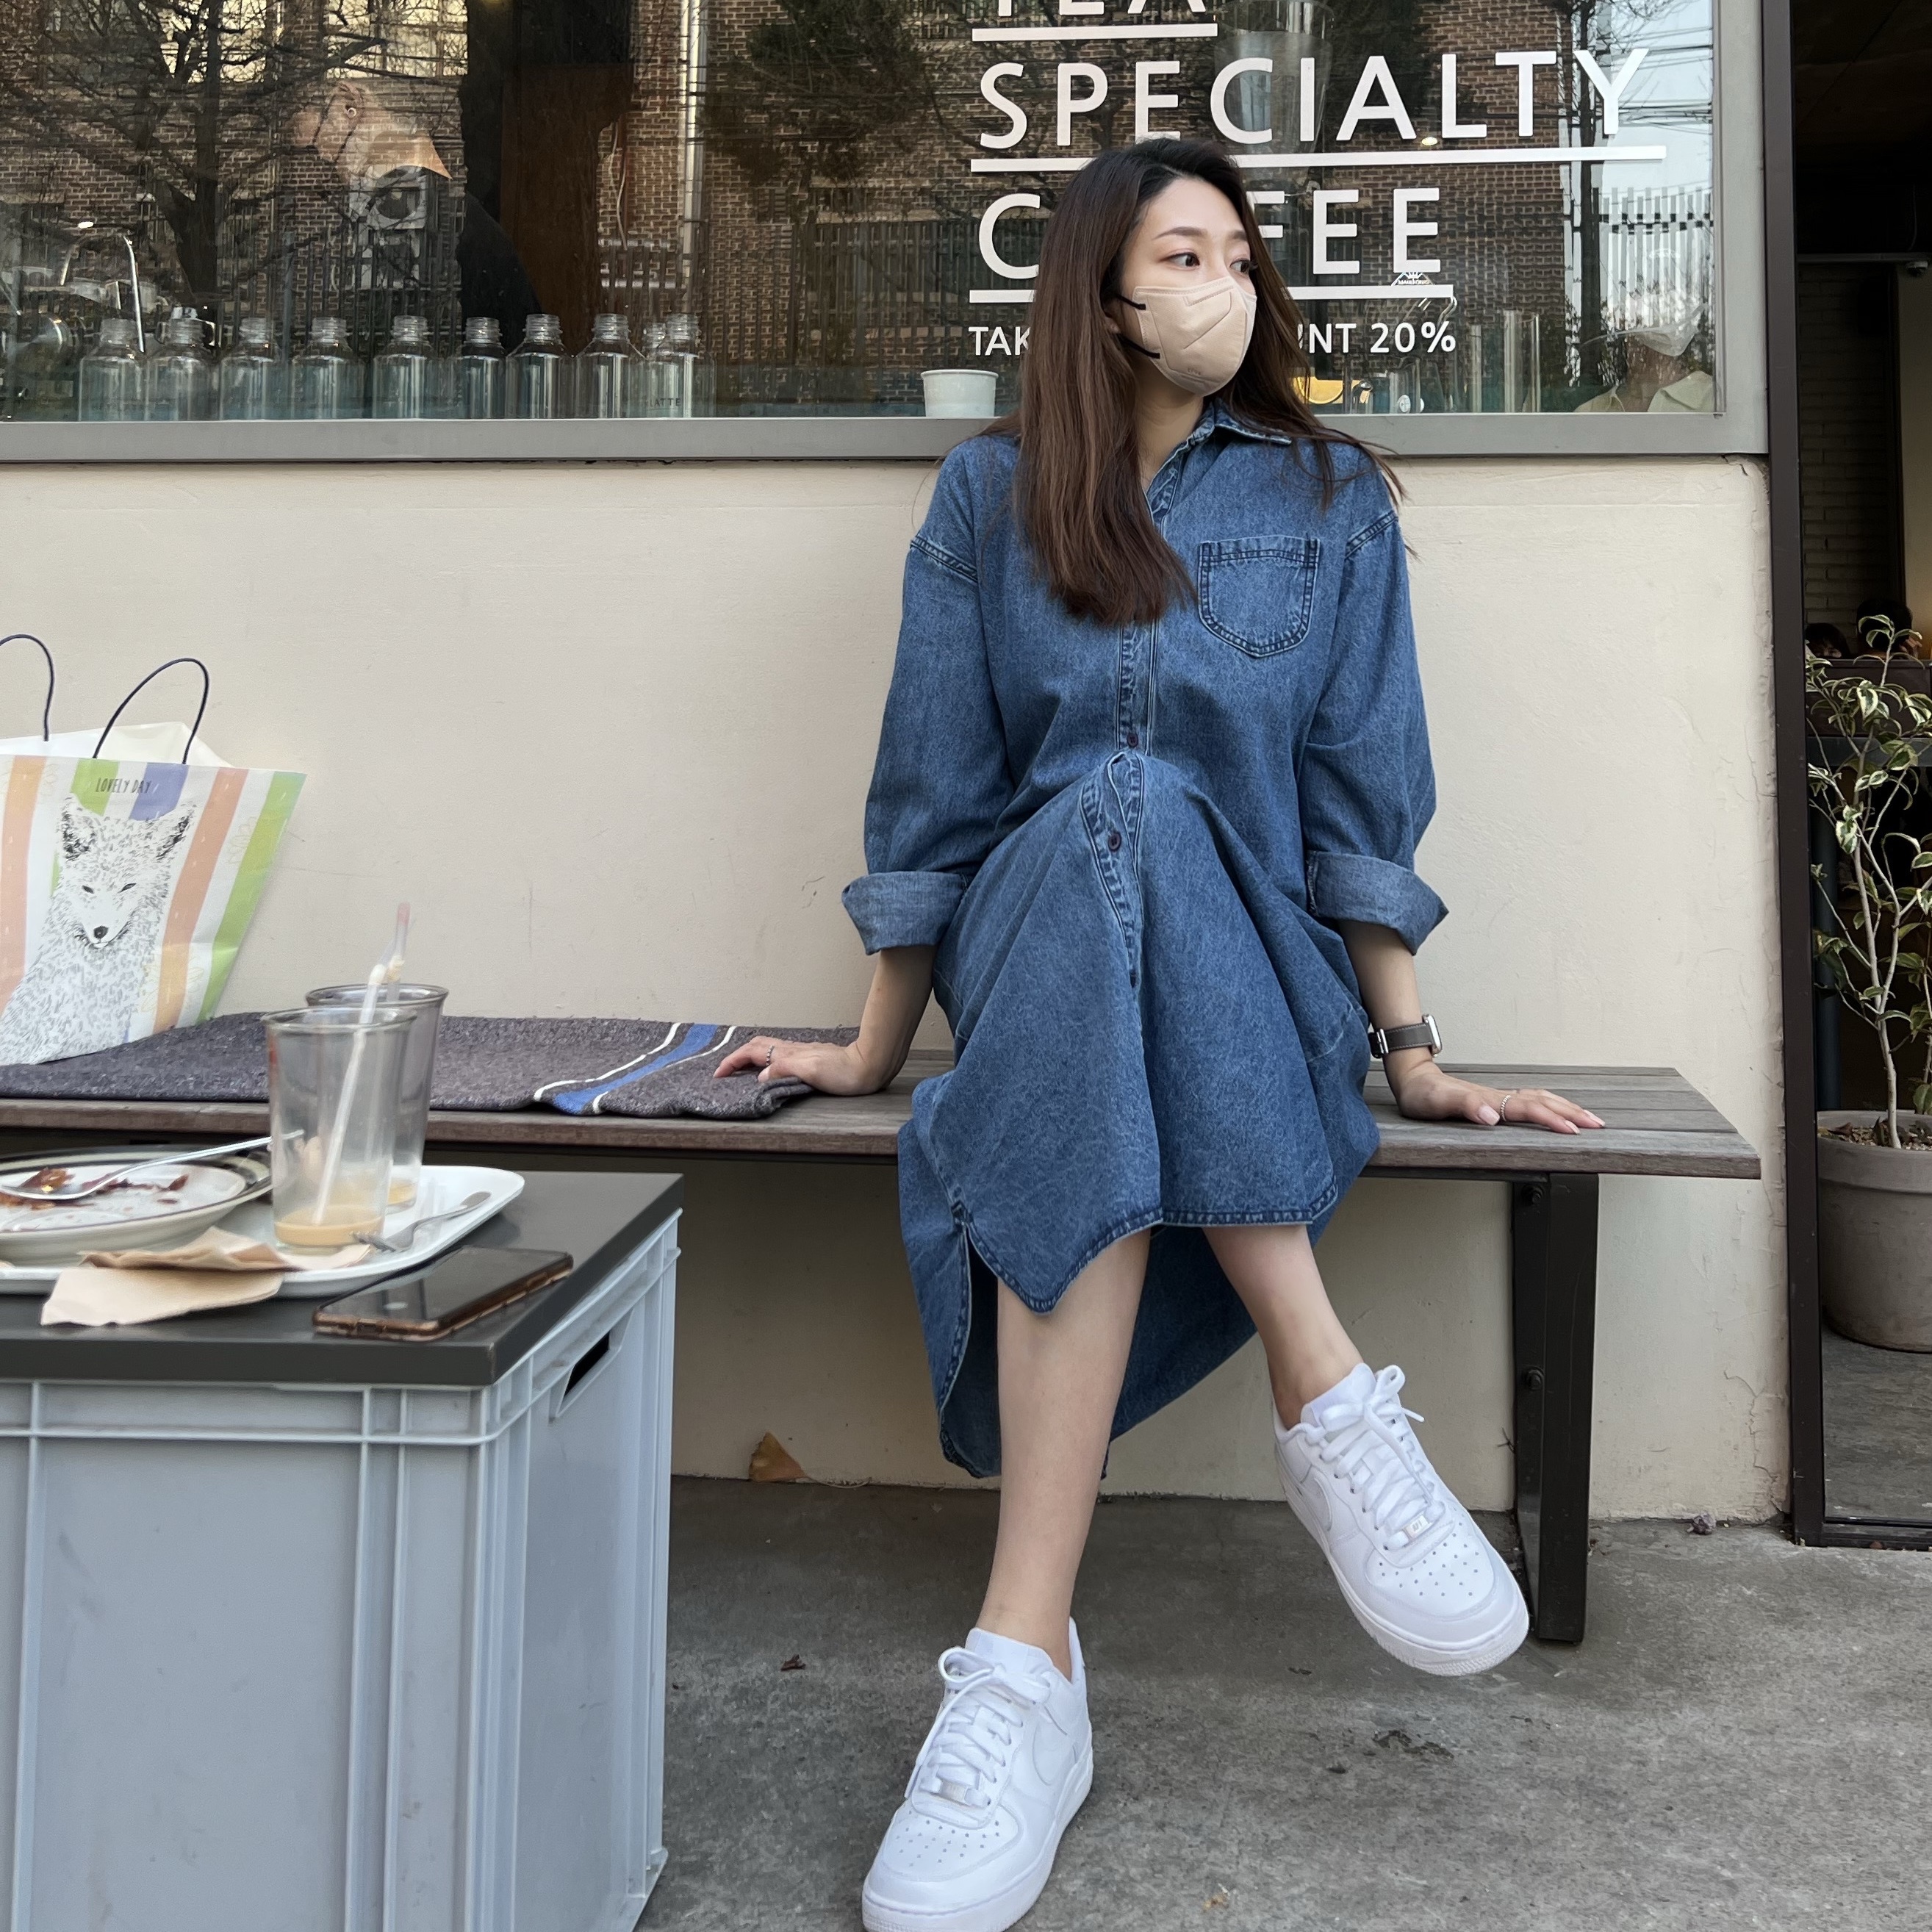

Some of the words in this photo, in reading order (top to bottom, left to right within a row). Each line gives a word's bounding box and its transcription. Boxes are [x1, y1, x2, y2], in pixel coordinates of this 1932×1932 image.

[980, 48, 1648, 149] SPECIALTY
[1370, 321, 1457, 353] 20%
[96, 777, 130, 794] LOVELY
[131, 779, 151, 794] DAY
